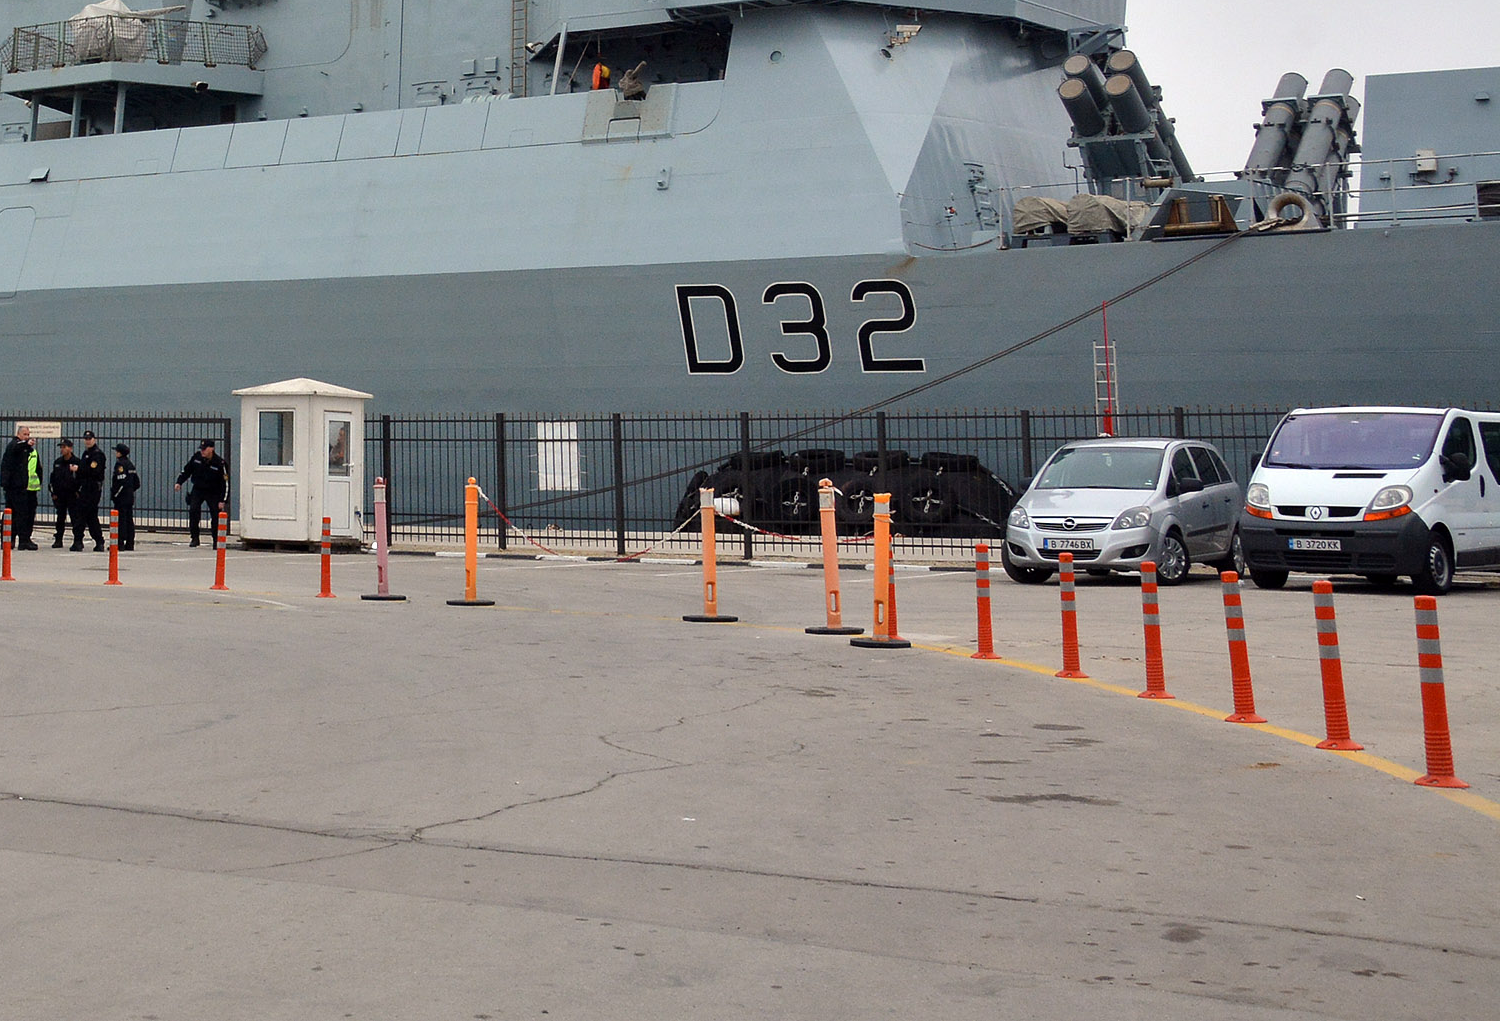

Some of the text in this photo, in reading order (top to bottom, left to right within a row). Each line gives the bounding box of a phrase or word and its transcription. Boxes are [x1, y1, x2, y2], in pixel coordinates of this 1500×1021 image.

[675, 278, 927, 376] D32
[1060, 540, 1080, 549] 7746
[1080, 541, 1091, 549] BX
[1306, 540, 1326, 550] 3720
[1327, 541, 1339, 550] KK
